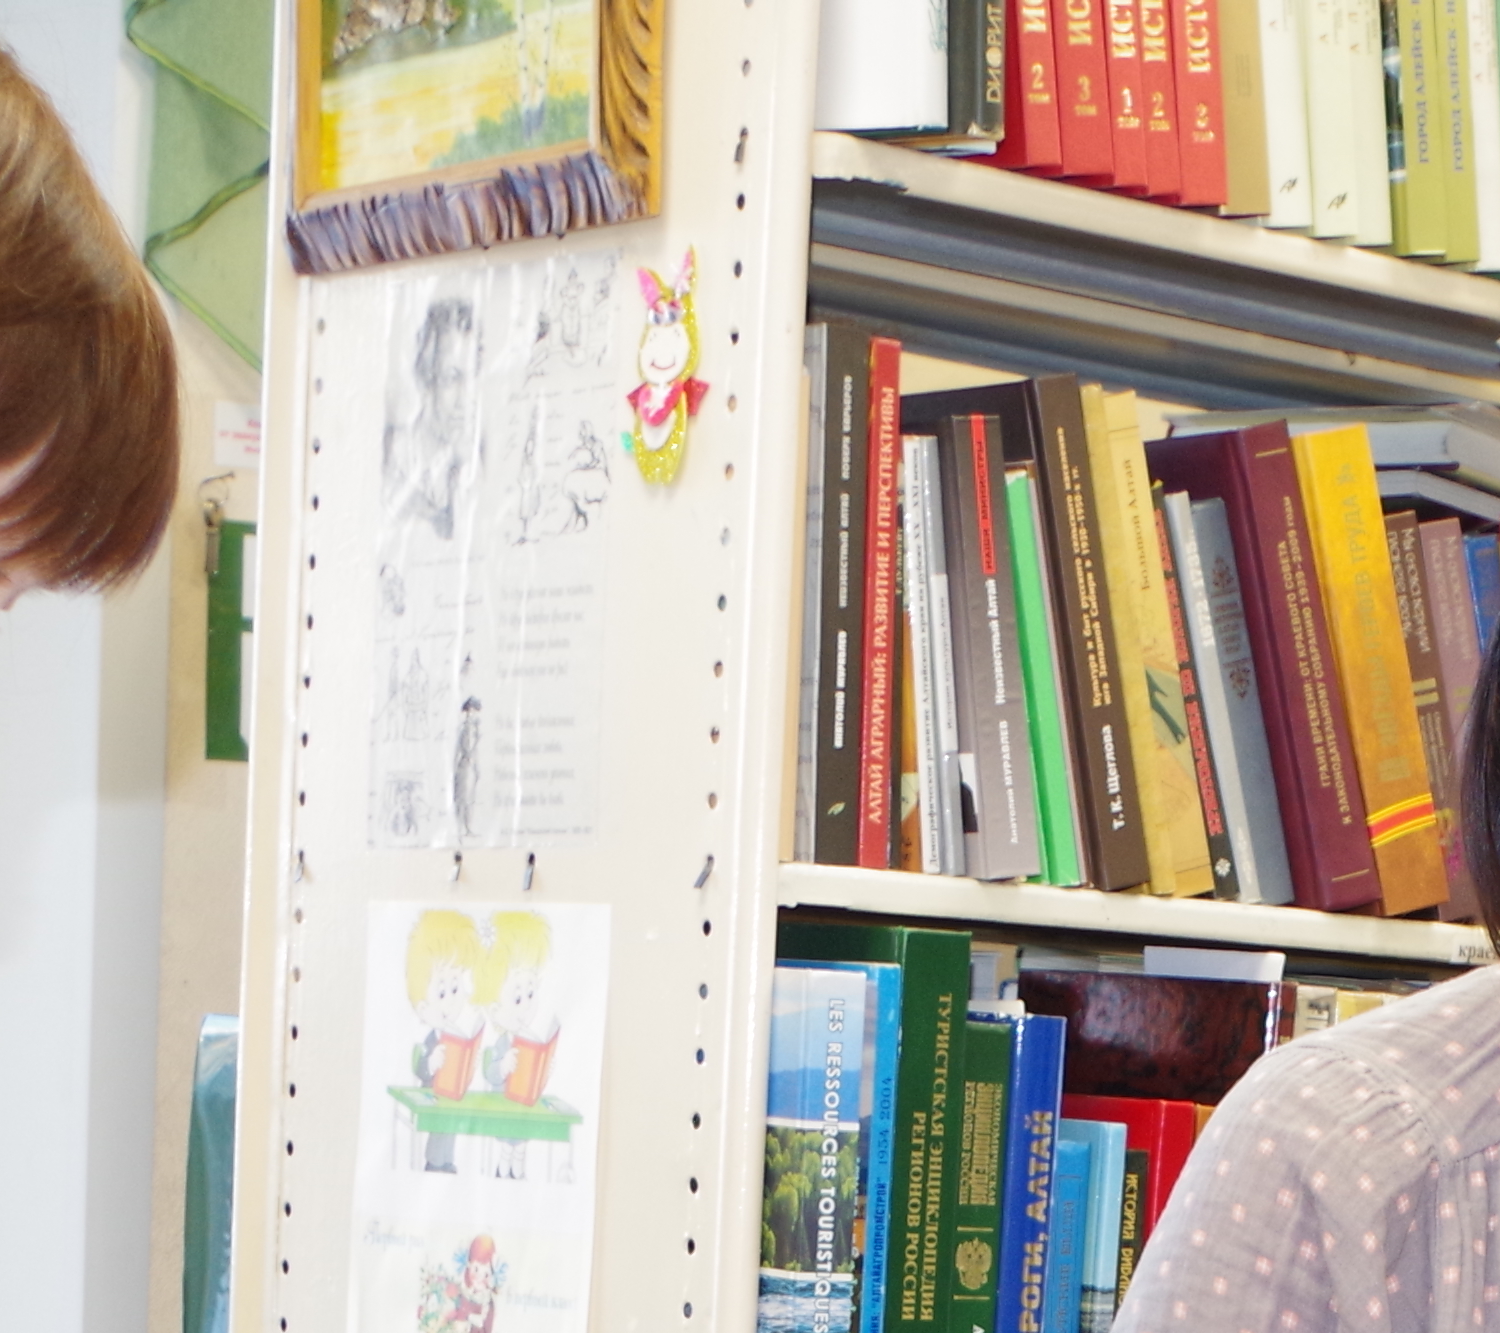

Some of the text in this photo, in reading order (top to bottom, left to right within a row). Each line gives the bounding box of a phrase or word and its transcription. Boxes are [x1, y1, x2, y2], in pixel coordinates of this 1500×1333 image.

[1031, 63, 1044, 90] 2
[1077, 75, 1091, 102] 3
[1122, 87, 1134, 114] 1
[1151, 92, 1165, 117] 2
[1408, 19, 1431, 164] ГОРОД АЛЕЙСК
[1444, 27, 1466, 172] ГОРОД АЛЕЙСК
[1062, 492, 1084, 554] сельского
[1127, 513, 1153, 592] Большой
[865, 386, 896, 824] АЛТАЙ АГРАРНЫЙ: РАЗВИТИЕ И ПЕРСПЕКТИВЫ
[1072, 556, 1092, 610] русского
[1082, 569, 1103, 618] Сибири
[918, 636, 932, 706] Алтайского
[983, 577, 1007, 706] Неизвестный Алтай
[1090, 618, 1111, 678] Западной
[1274, 539, 1333, 787] ГРАНИ ВРЕМЕНИ: ОТ КРАЕВОГО СОВЕТА
[1301, 604, 1326, 679] СОБРАНИЮ
[1085, 651, 1107, 708] Культура
[997, 718, 1019, 845] Анатолий МУРАВЛЕВ
[1098, 722, 1123, 794] Щеглова
[1316, 680, 1352, 813] ЗАКОНОДАТЕЛЬНОМУ
[824, 998, 846, 1032] LES
[818, 1042, 844, 1178] RESSOURCES
[879, 1075, 893, 1119] 2004
[877, 1127, 890, 1166] 1954
[917, 992, 954, 1322] ТУРИСТСКАЯ ЭНЦИКЛОПЕДИЯ
[958, 1151, 972, 1206] РОССИИ
[969, 1081, 990, 1205] ЭНЦИКЛОПЕДИЯ
[985, 1082, 1004, 1207] ЭКОНОМИЧЕСКАЯ
[1022, 1108, 1055, 1223] АЛТАЙ
[900, 1111, 927, 1321] РЕГИОНОВ РОССИИ
[1118, 1171, 1140, 1241] ИСТОРИЯ
[810, 1197, 837, 1333] TOURISTIQUES
